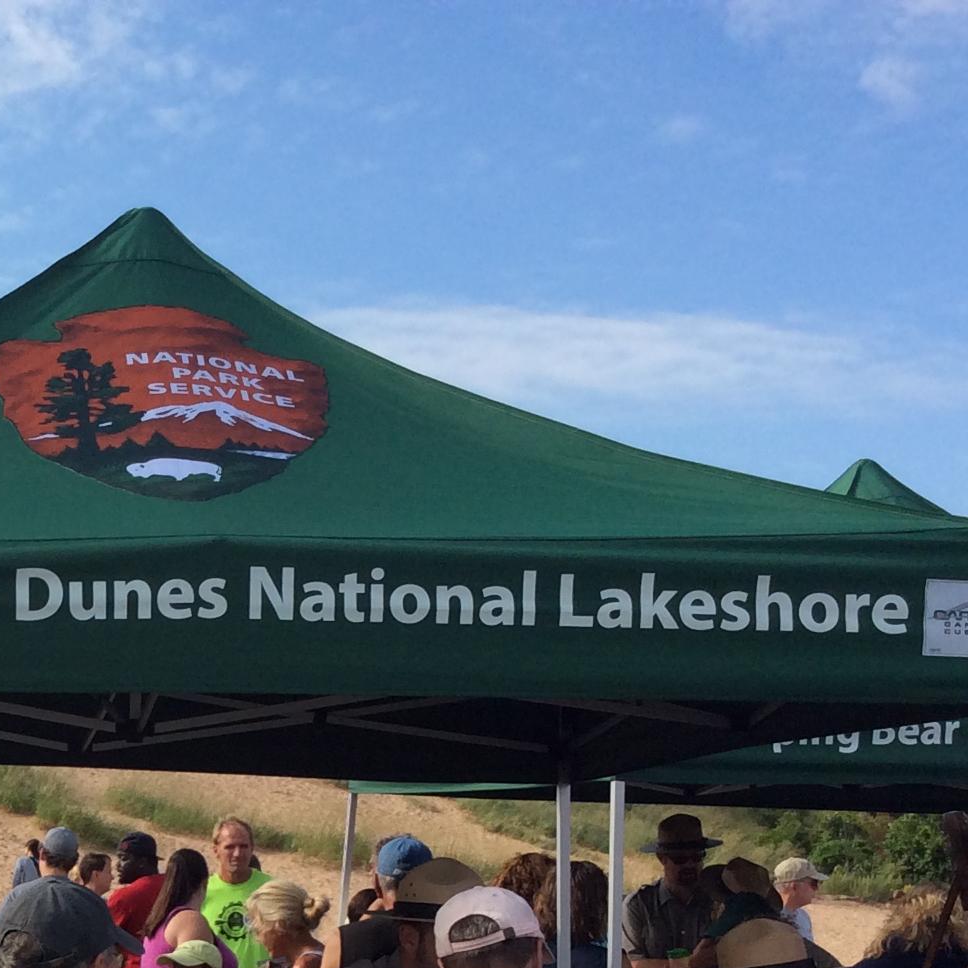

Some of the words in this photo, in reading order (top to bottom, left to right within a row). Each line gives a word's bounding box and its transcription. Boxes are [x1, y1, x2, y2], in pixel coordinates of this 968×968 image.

[125, 351, 305, 383] NATIONAL
[172, 367, 250, 391] PARK
[147, 382, 296, 408] SERVICE
[14, 567, 228, 622] Dunes
[248, 565, 537, 626] National
[558, 572, 910, 635] Lakeshore
